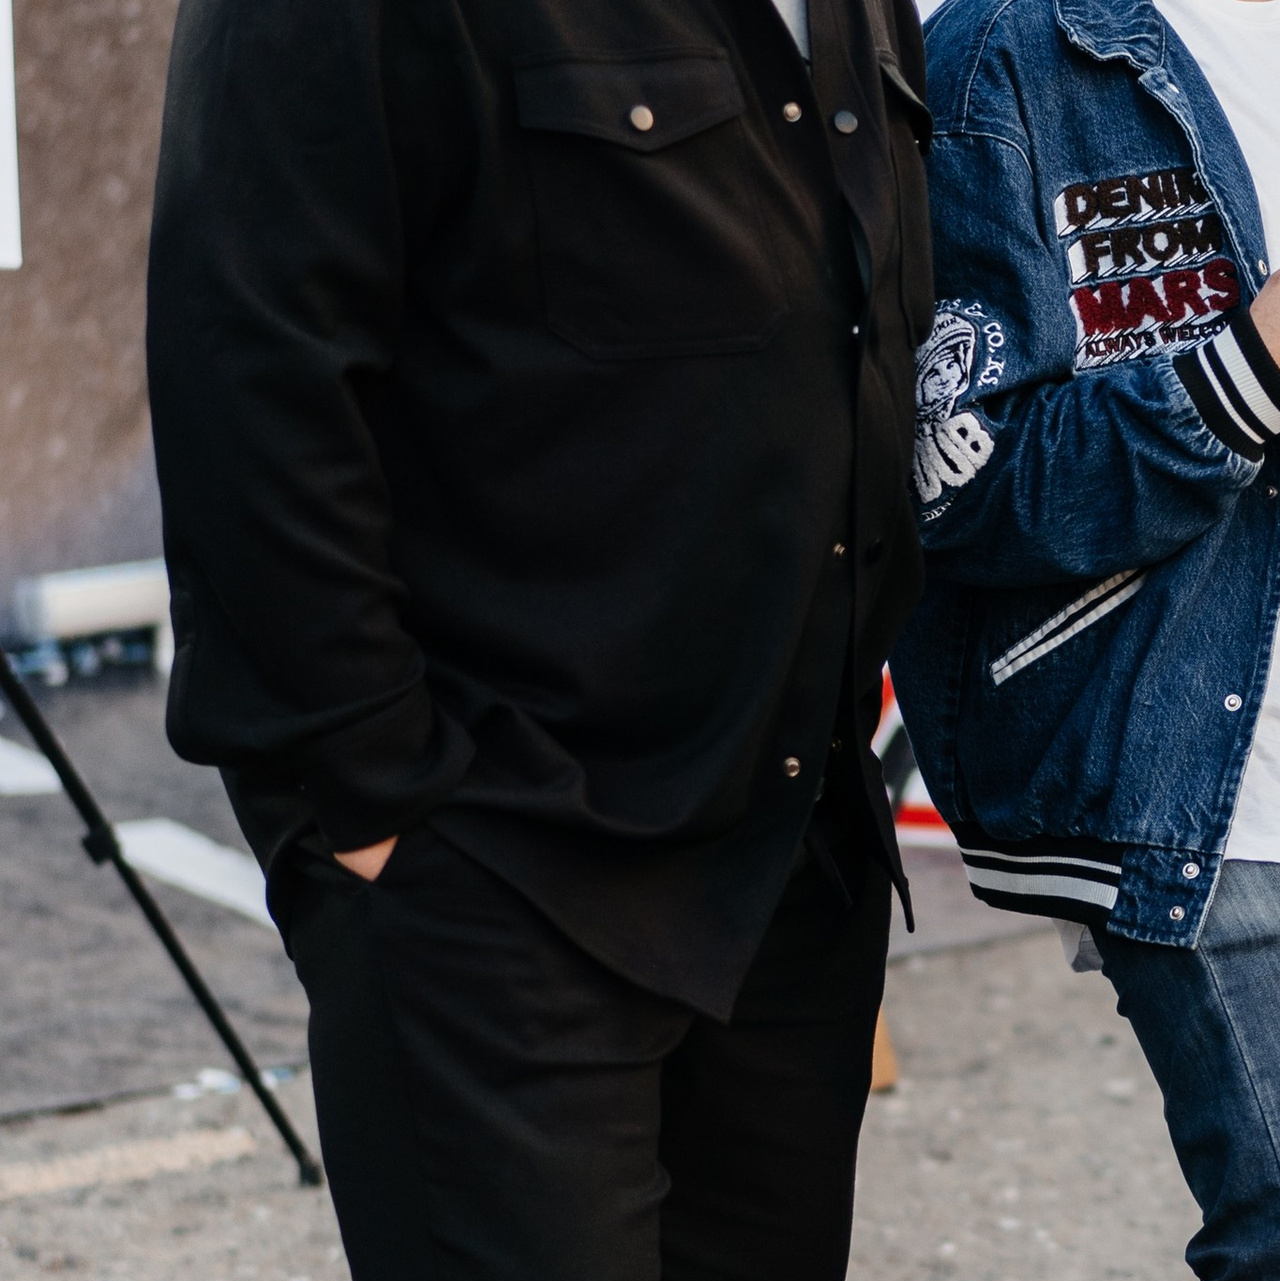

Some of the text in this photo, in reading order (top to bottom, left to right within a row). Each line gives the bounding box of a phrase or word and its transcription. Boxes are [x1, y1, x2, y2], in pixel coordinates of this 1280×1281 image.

[1069, 216, 1222, 282] FROM
[1070, 257, 1241, 336] MARS
[1084, 331, 1157, 358] ALWAYS
